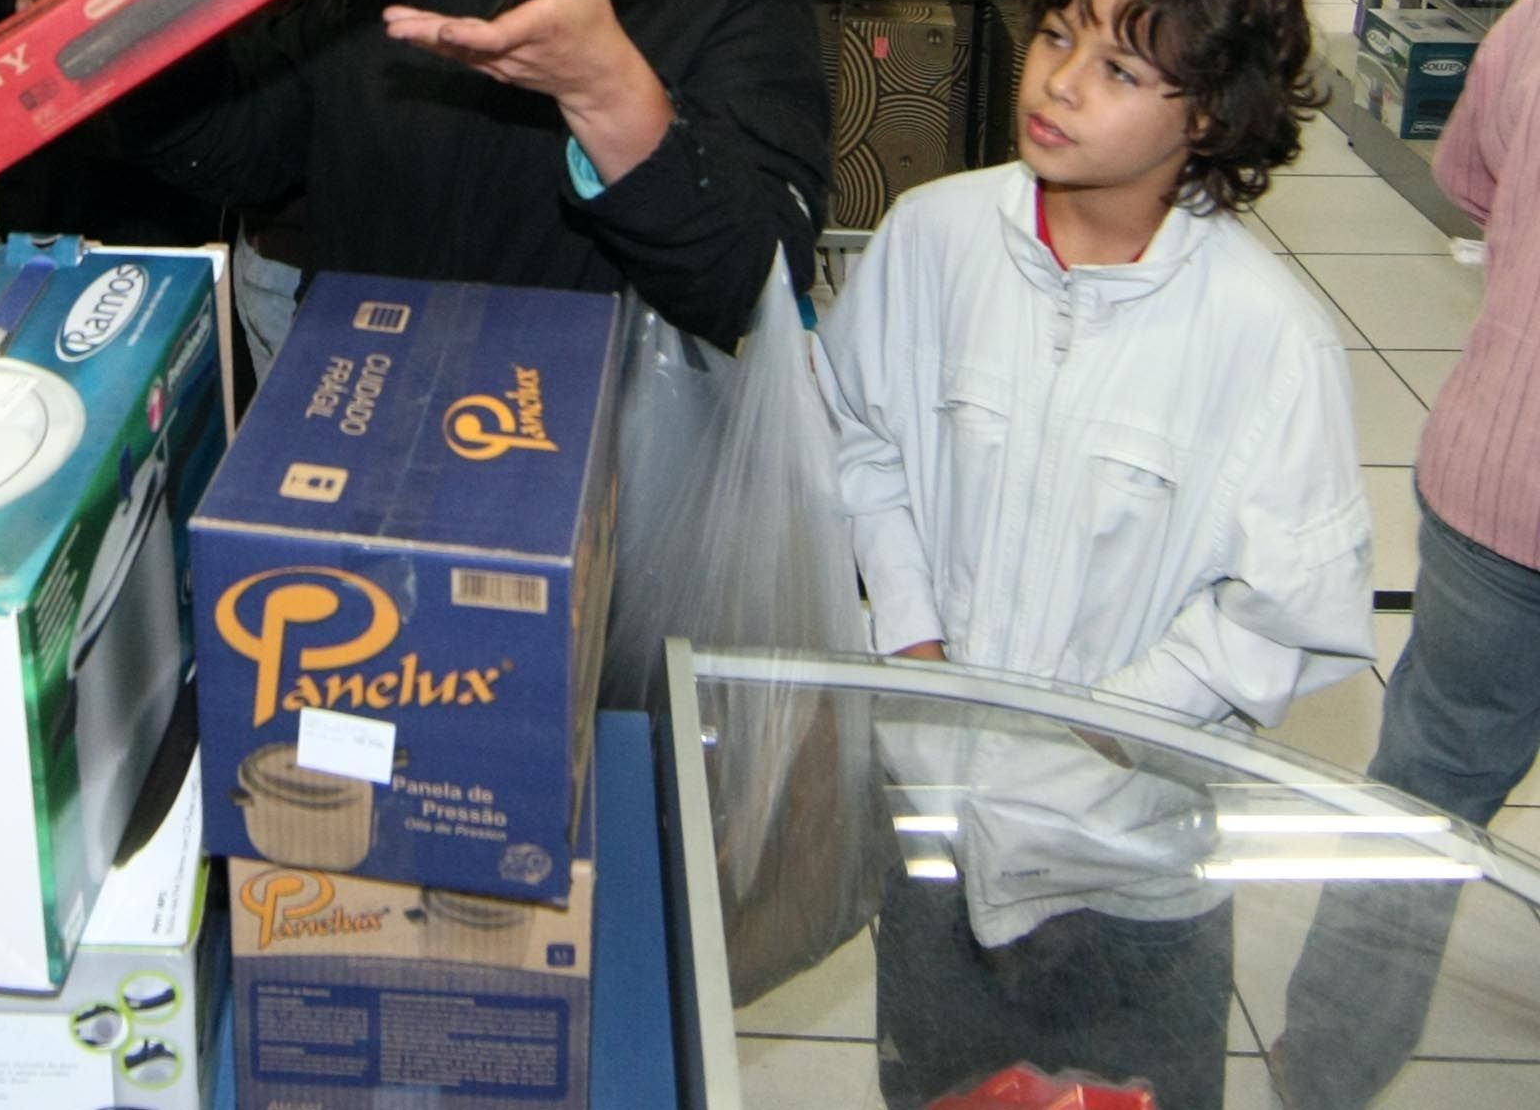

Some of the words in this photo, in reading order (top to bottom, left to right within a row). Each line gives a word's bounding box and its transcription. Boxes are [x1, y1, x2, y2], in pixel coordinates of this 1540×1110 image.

[65, 263, 142, 352] Ramos
[305, 356, 355, 419] FRÁGIL
[339, 353, 392, 437] CUIDADO
[442, 362, 559, 461] Panelux
[214, 565, 501, 728] Panelux
[393, 776, 463, 801] Panela
[467, 784, 494, 804] de
[423, 799, 507, 827] Pressão
